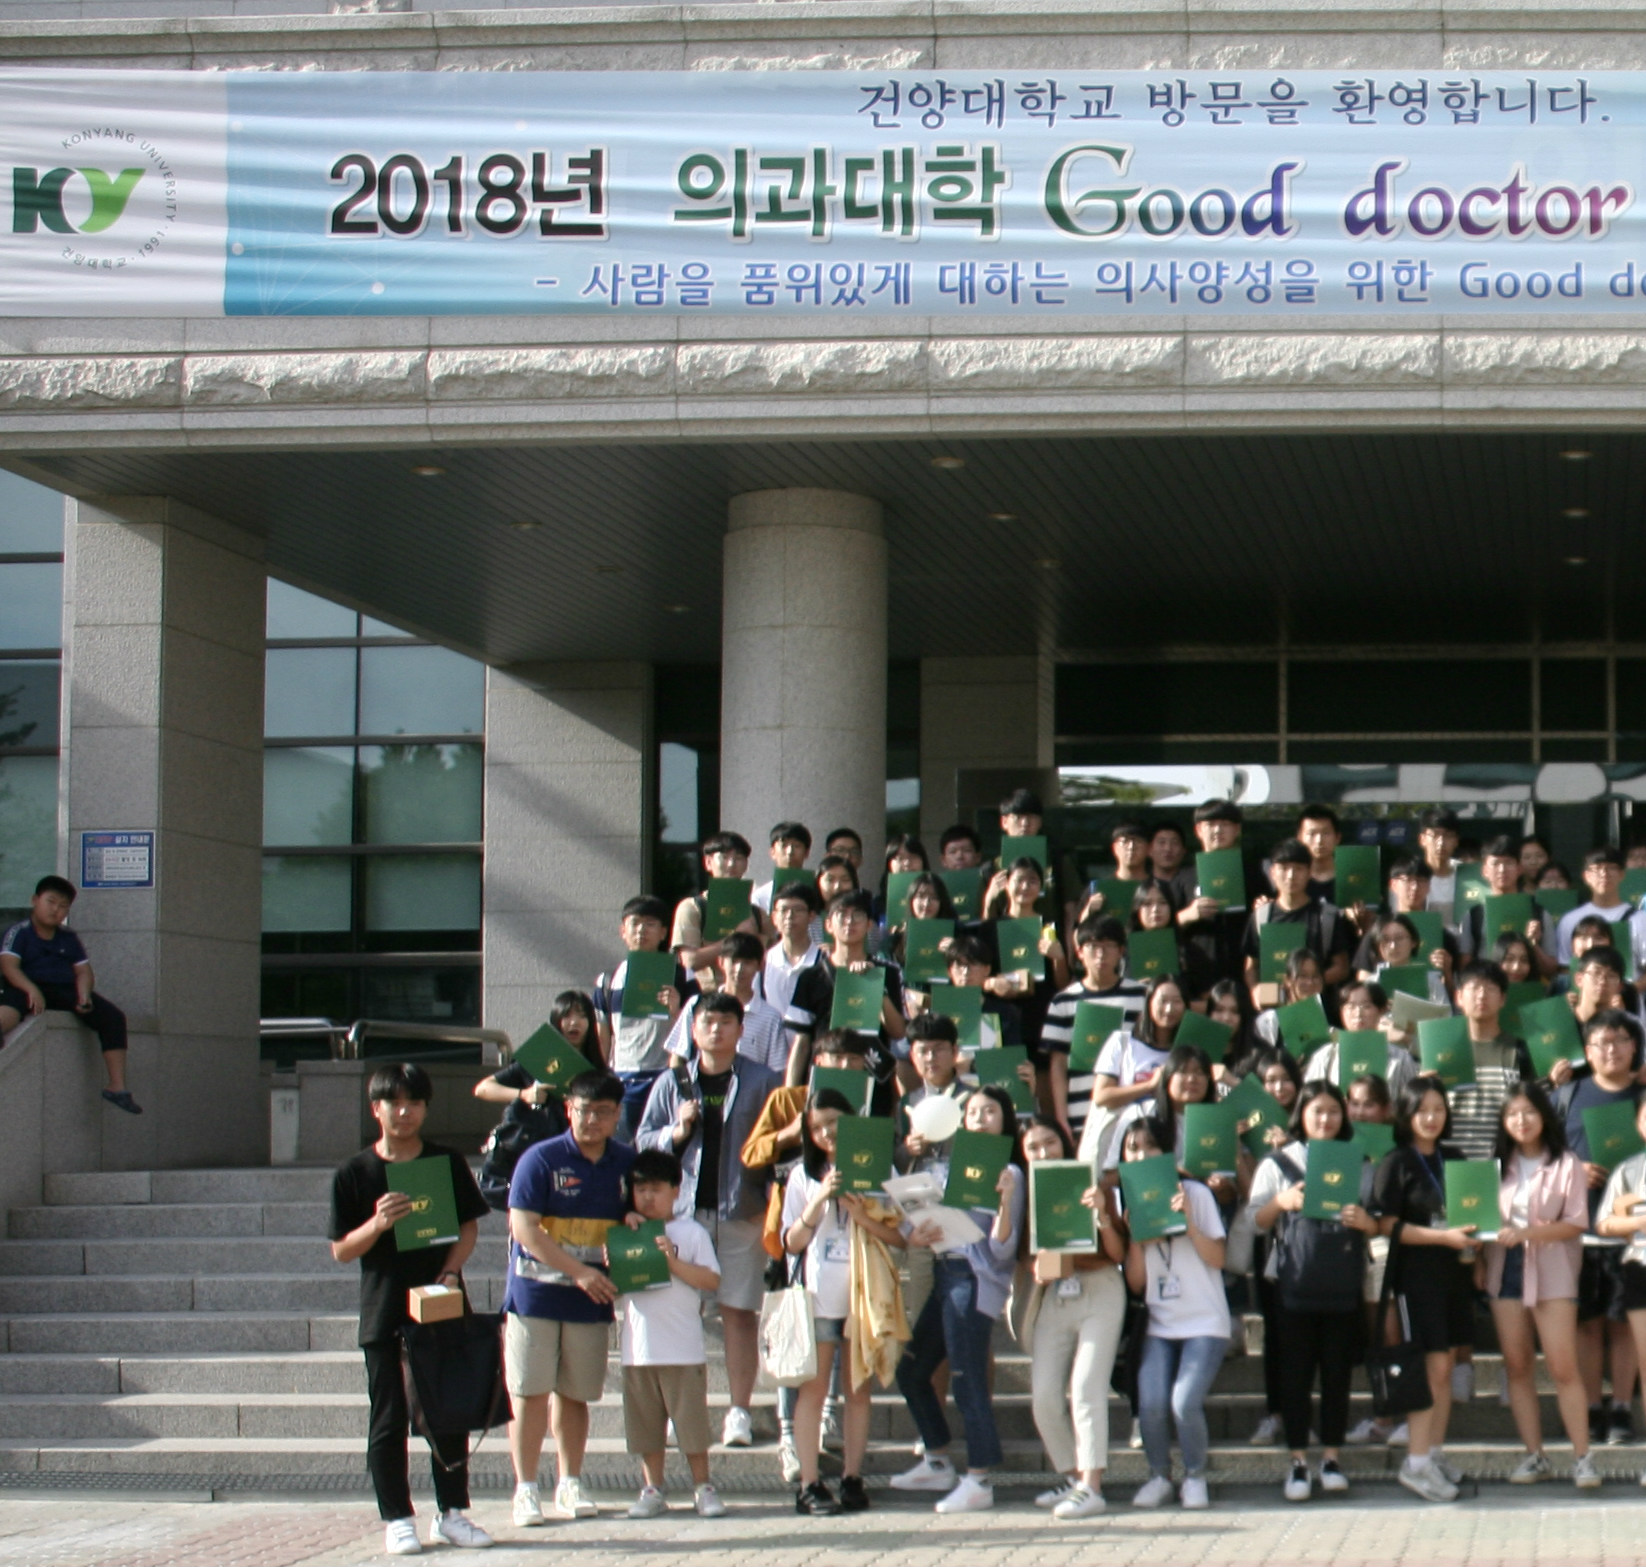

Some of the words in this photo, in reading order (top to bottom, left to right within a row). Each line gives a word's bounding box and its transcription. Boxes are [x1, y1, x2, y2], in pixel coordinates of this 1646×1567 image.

[857, 77, 1119, 128] 건양대학교
[1147, 76, 1309, 126] 방문을
[1332, 77, 1611, 126] 환영합니다.
[62, 128, 136, 149] KONYANG
[140, 140, 177, 222] UNIVERSITY
[329, 147, 604, 237] 2018년
[674, 143, 1004, 238] 의과대학
[1046, 144, 1300, 238] Good
[1345, 160, 1630, 238] doctor
[138, 230, 165, 258] 1991
[581, 262, 715, 306] 사람을
[740, 262, 912, 306] 품위있게
[939, 261, 1070, 305] 대하는
[1095, 259, 1318, 304] 의사양성을
[1347, 259, 1432, 304] 위한
[1459, 261, 1585, 298] Good
